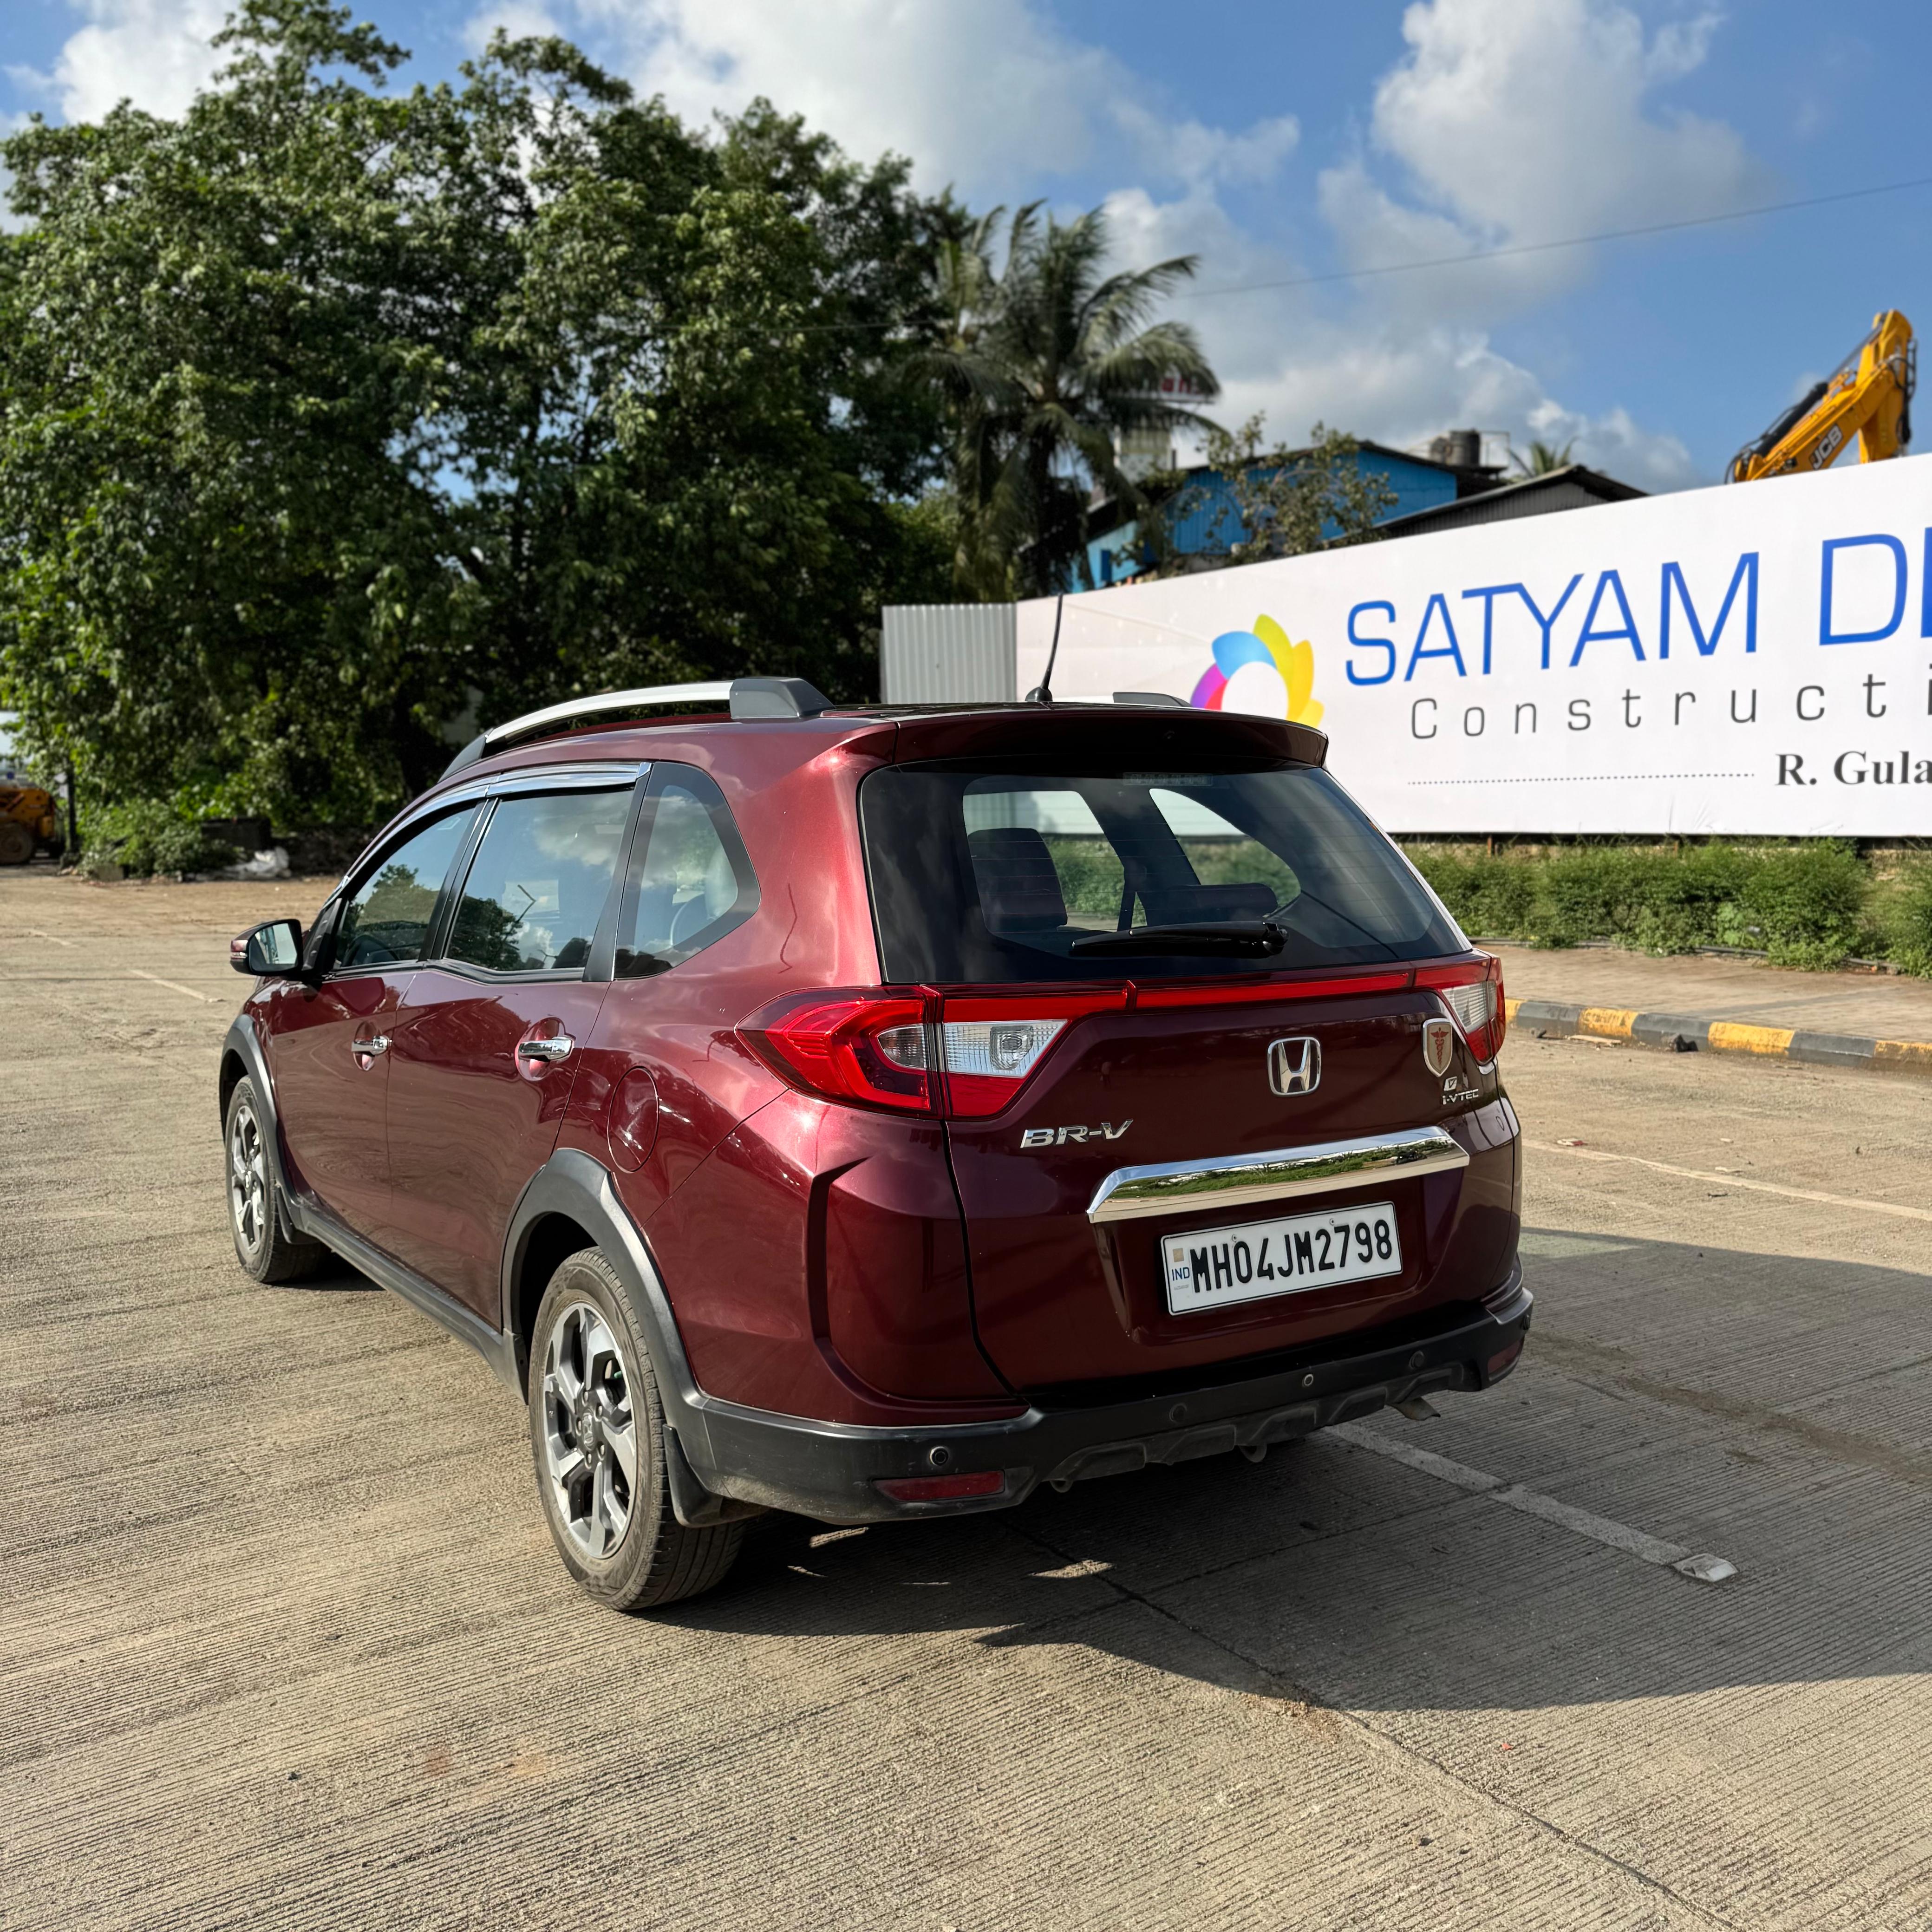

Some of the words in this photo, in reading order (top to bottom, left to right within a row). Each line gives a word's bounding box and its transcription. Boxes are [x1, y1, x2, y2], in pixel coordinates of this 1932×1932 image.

[1813, 425, 1842, 470] JCB
[1345, 551, 1759, 686] SATYAM
[1819, 527, 1932, 646] D
[1774, 753, 1817, 786] R.
[1834, 751, 1932, 785] Gula
[1020, 1118, 1134, 1148] BR-V
[1172, 1267, 1190, 1281] IND
[1189, 1219, 1392, 1293] MH04JM2798
